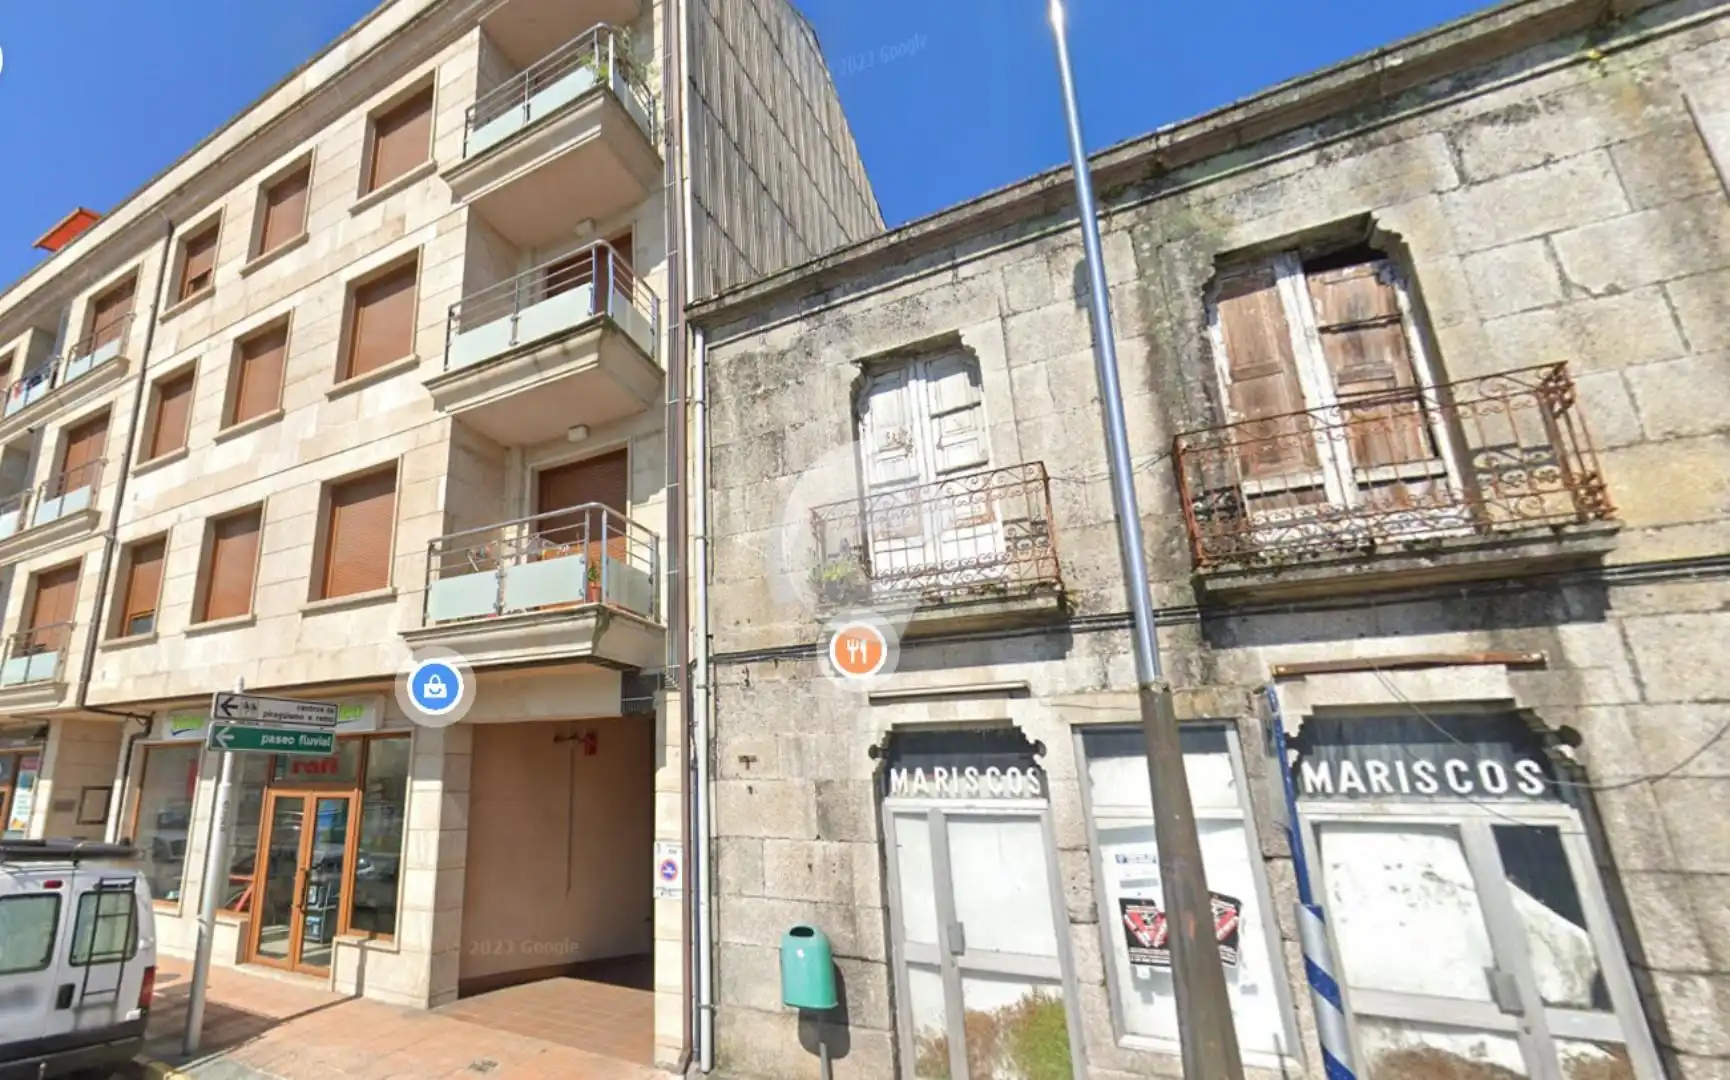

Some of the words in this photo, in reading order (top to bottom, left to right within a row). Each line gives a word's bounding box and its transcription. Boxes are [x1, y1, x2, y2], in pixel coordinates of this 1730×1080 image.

[260, 734, 296, 745] paseo
[299, 735, 331, 747] fluvial
[890, 766, 1041, 796] MARISCOS
[1301, 759, 1545, 795] MARISCOS
